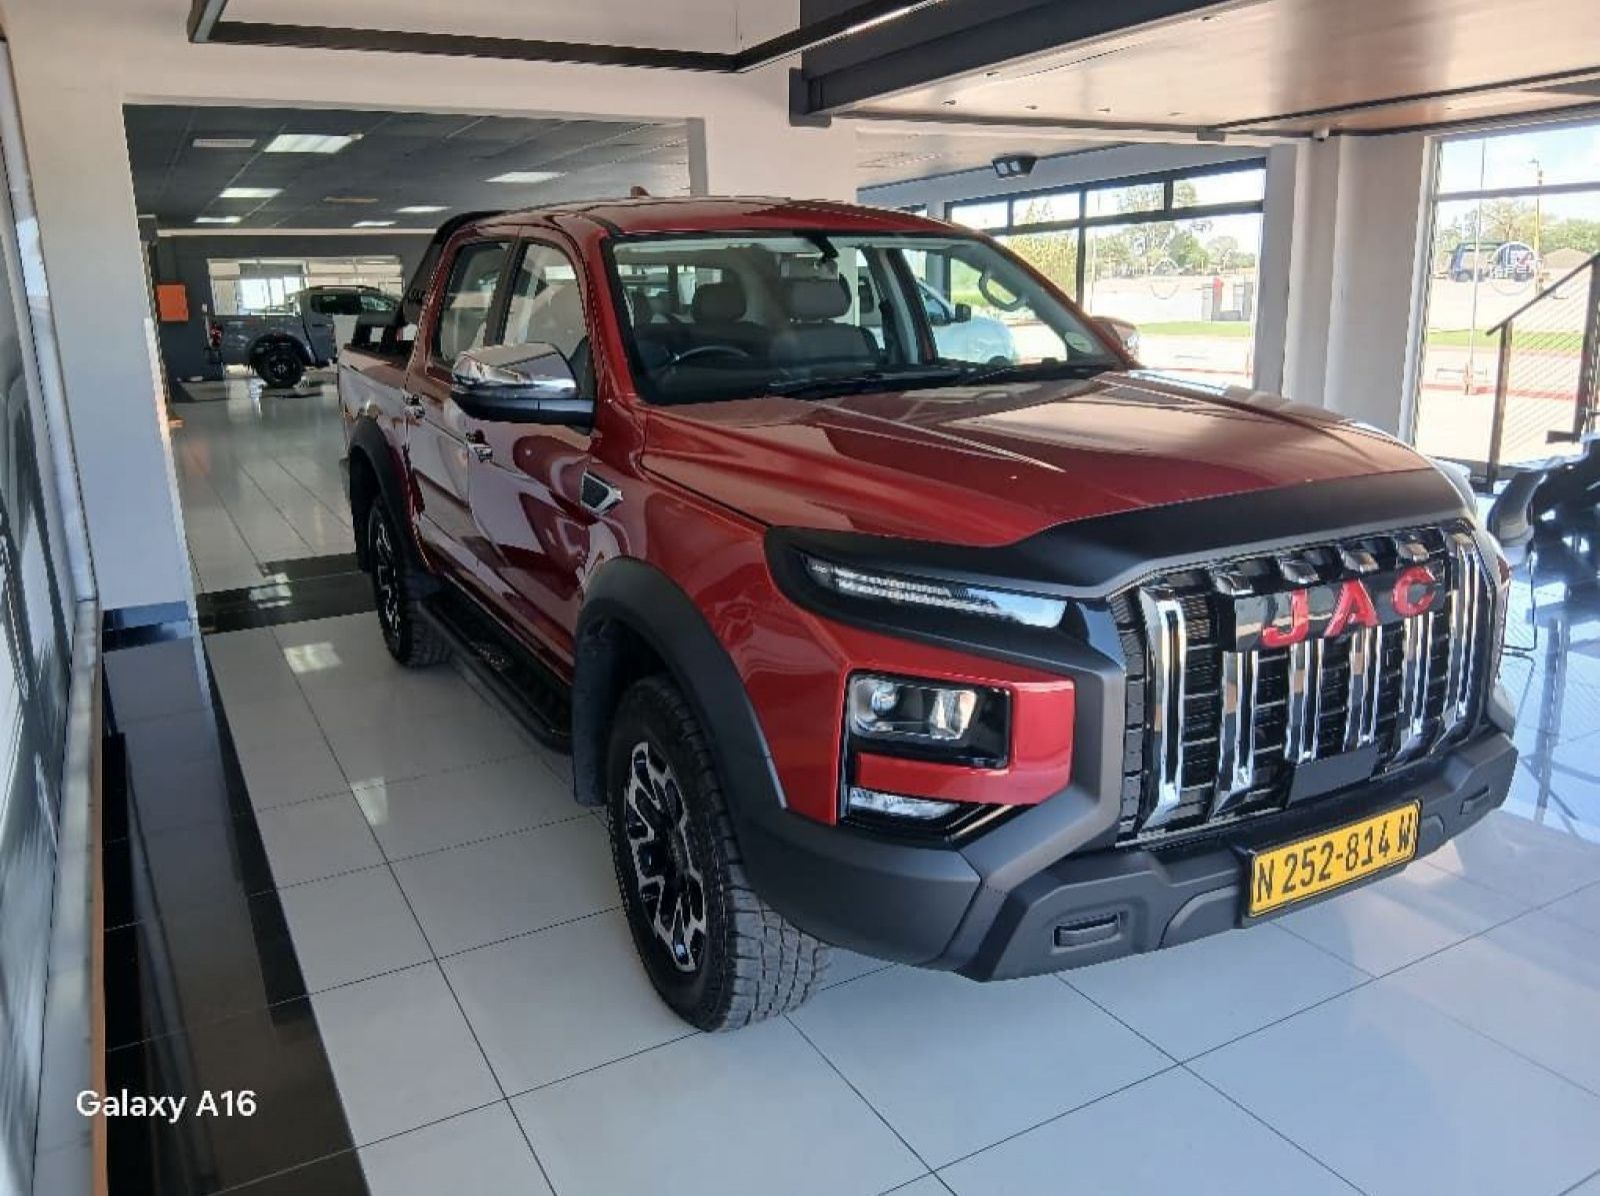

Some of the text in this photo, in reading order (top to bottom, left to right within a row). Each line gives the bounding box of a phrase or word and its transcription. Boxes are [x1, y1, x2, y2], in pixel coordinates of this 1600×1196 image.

[1260, 565, 1436, 649] JAC
[1256, 812, 1413, 903] N 252-814 W
